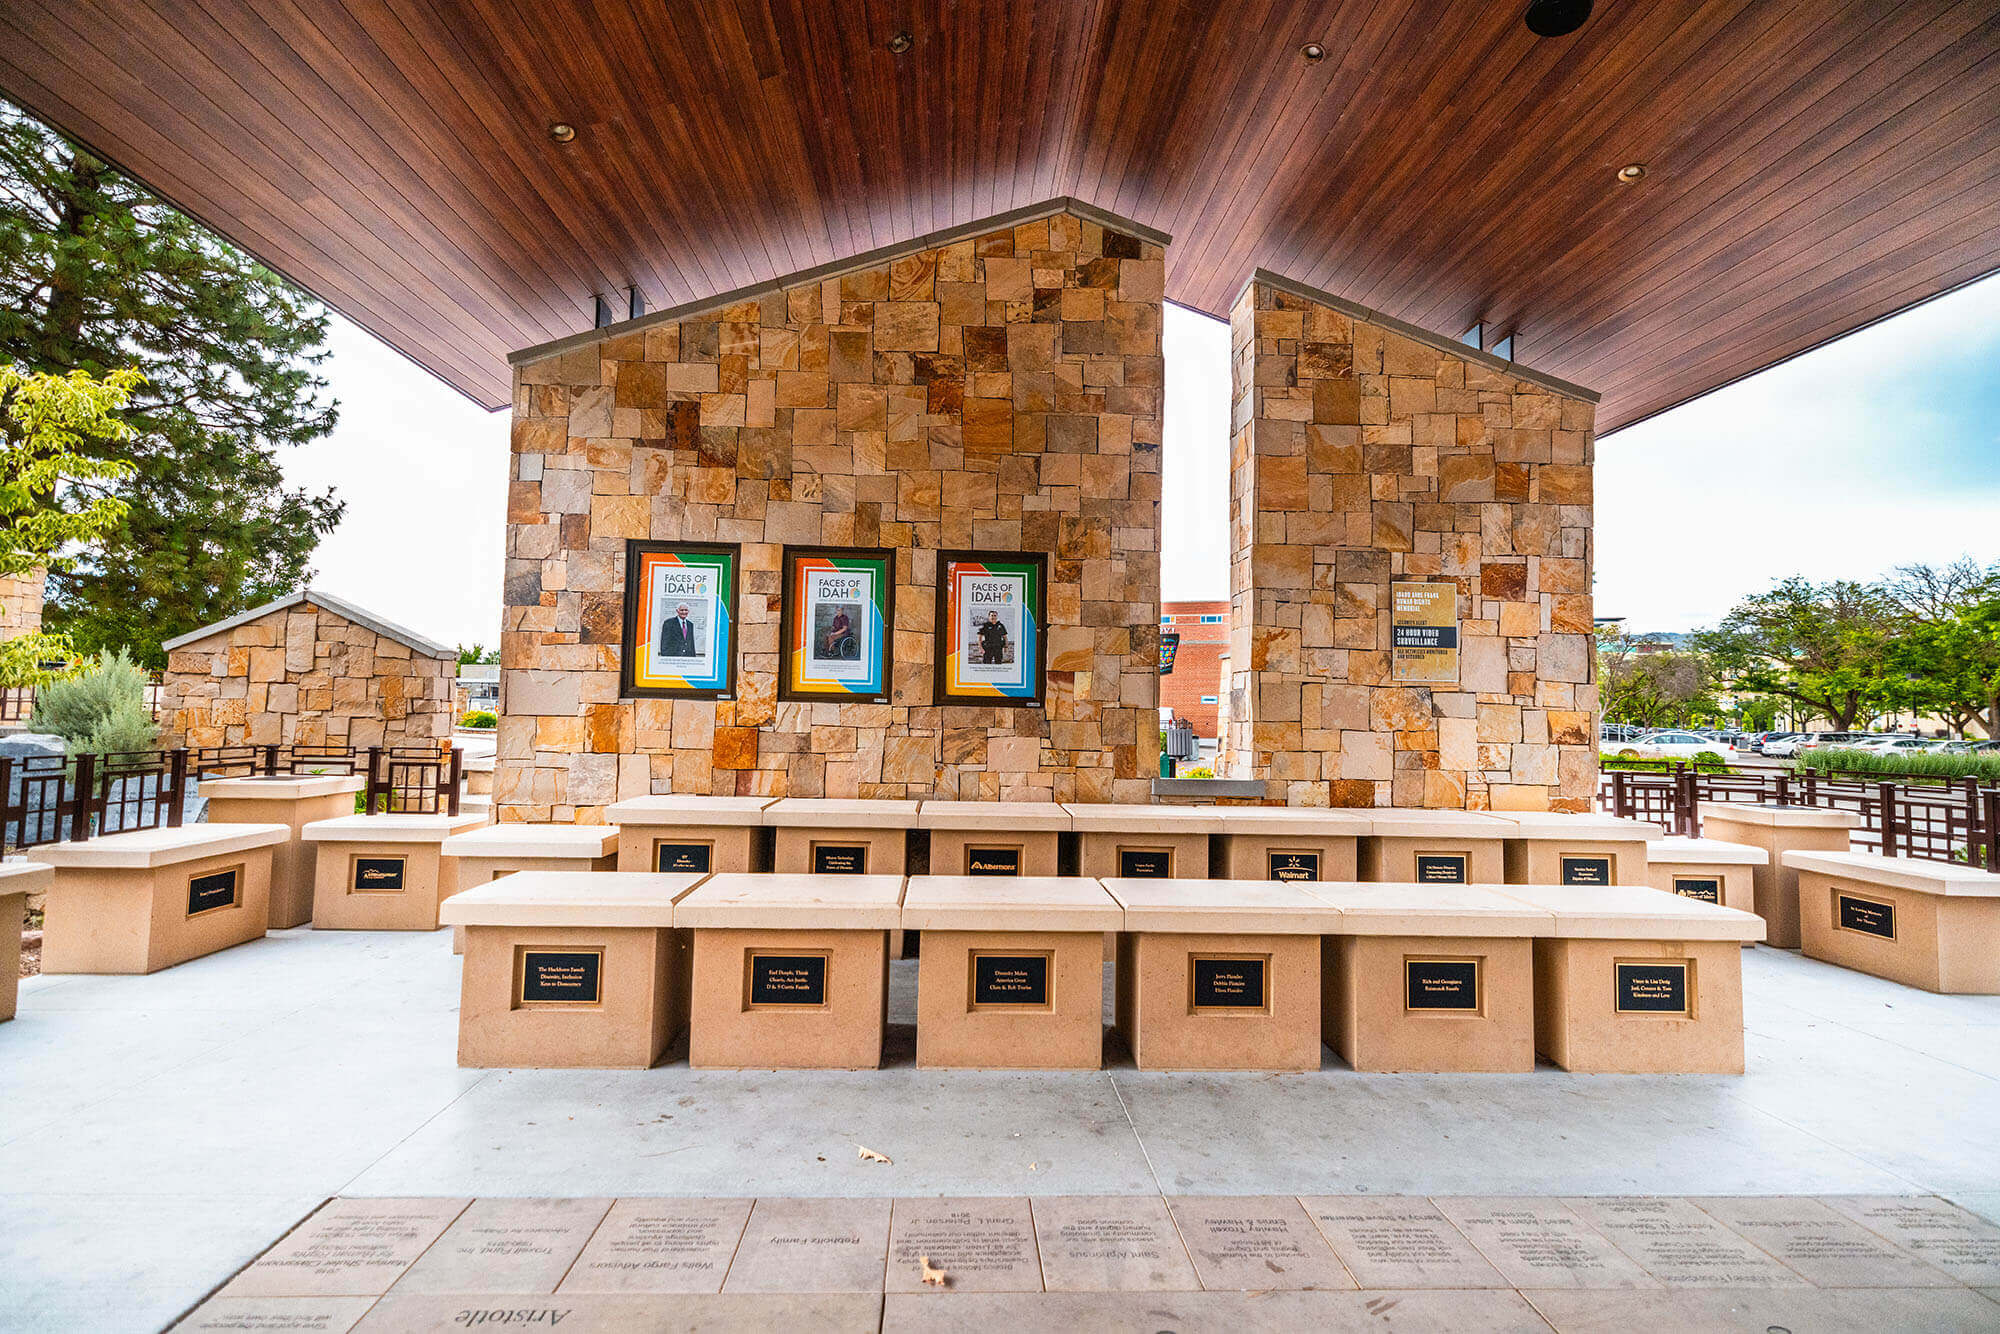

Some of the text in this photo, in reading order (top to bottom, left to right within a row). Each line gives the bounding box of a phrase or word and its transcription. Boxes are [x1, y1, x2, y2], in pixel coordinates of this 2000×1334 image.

[665, 574, 707, 583] FACES OF
[819, 579, 845, 587] FACES
[971, 583, 1012, 592] FACES OF
[1422, 629, 1439, 637] VIDEO
[1396, 638, 1438, 646] SURVEILLANCE
[1278, 871, 1309, 880] Walmart
[1246, 1225, 1289, 1233] Hawley
[768, 1236, 808, 1244] Family
[1067, 1250, 1160, 1259] Saint Alphonsus
[585, 1260, 715, 1270] Wells Fargo Advisors
[454, 1309, 572, 1327] Aristotle
